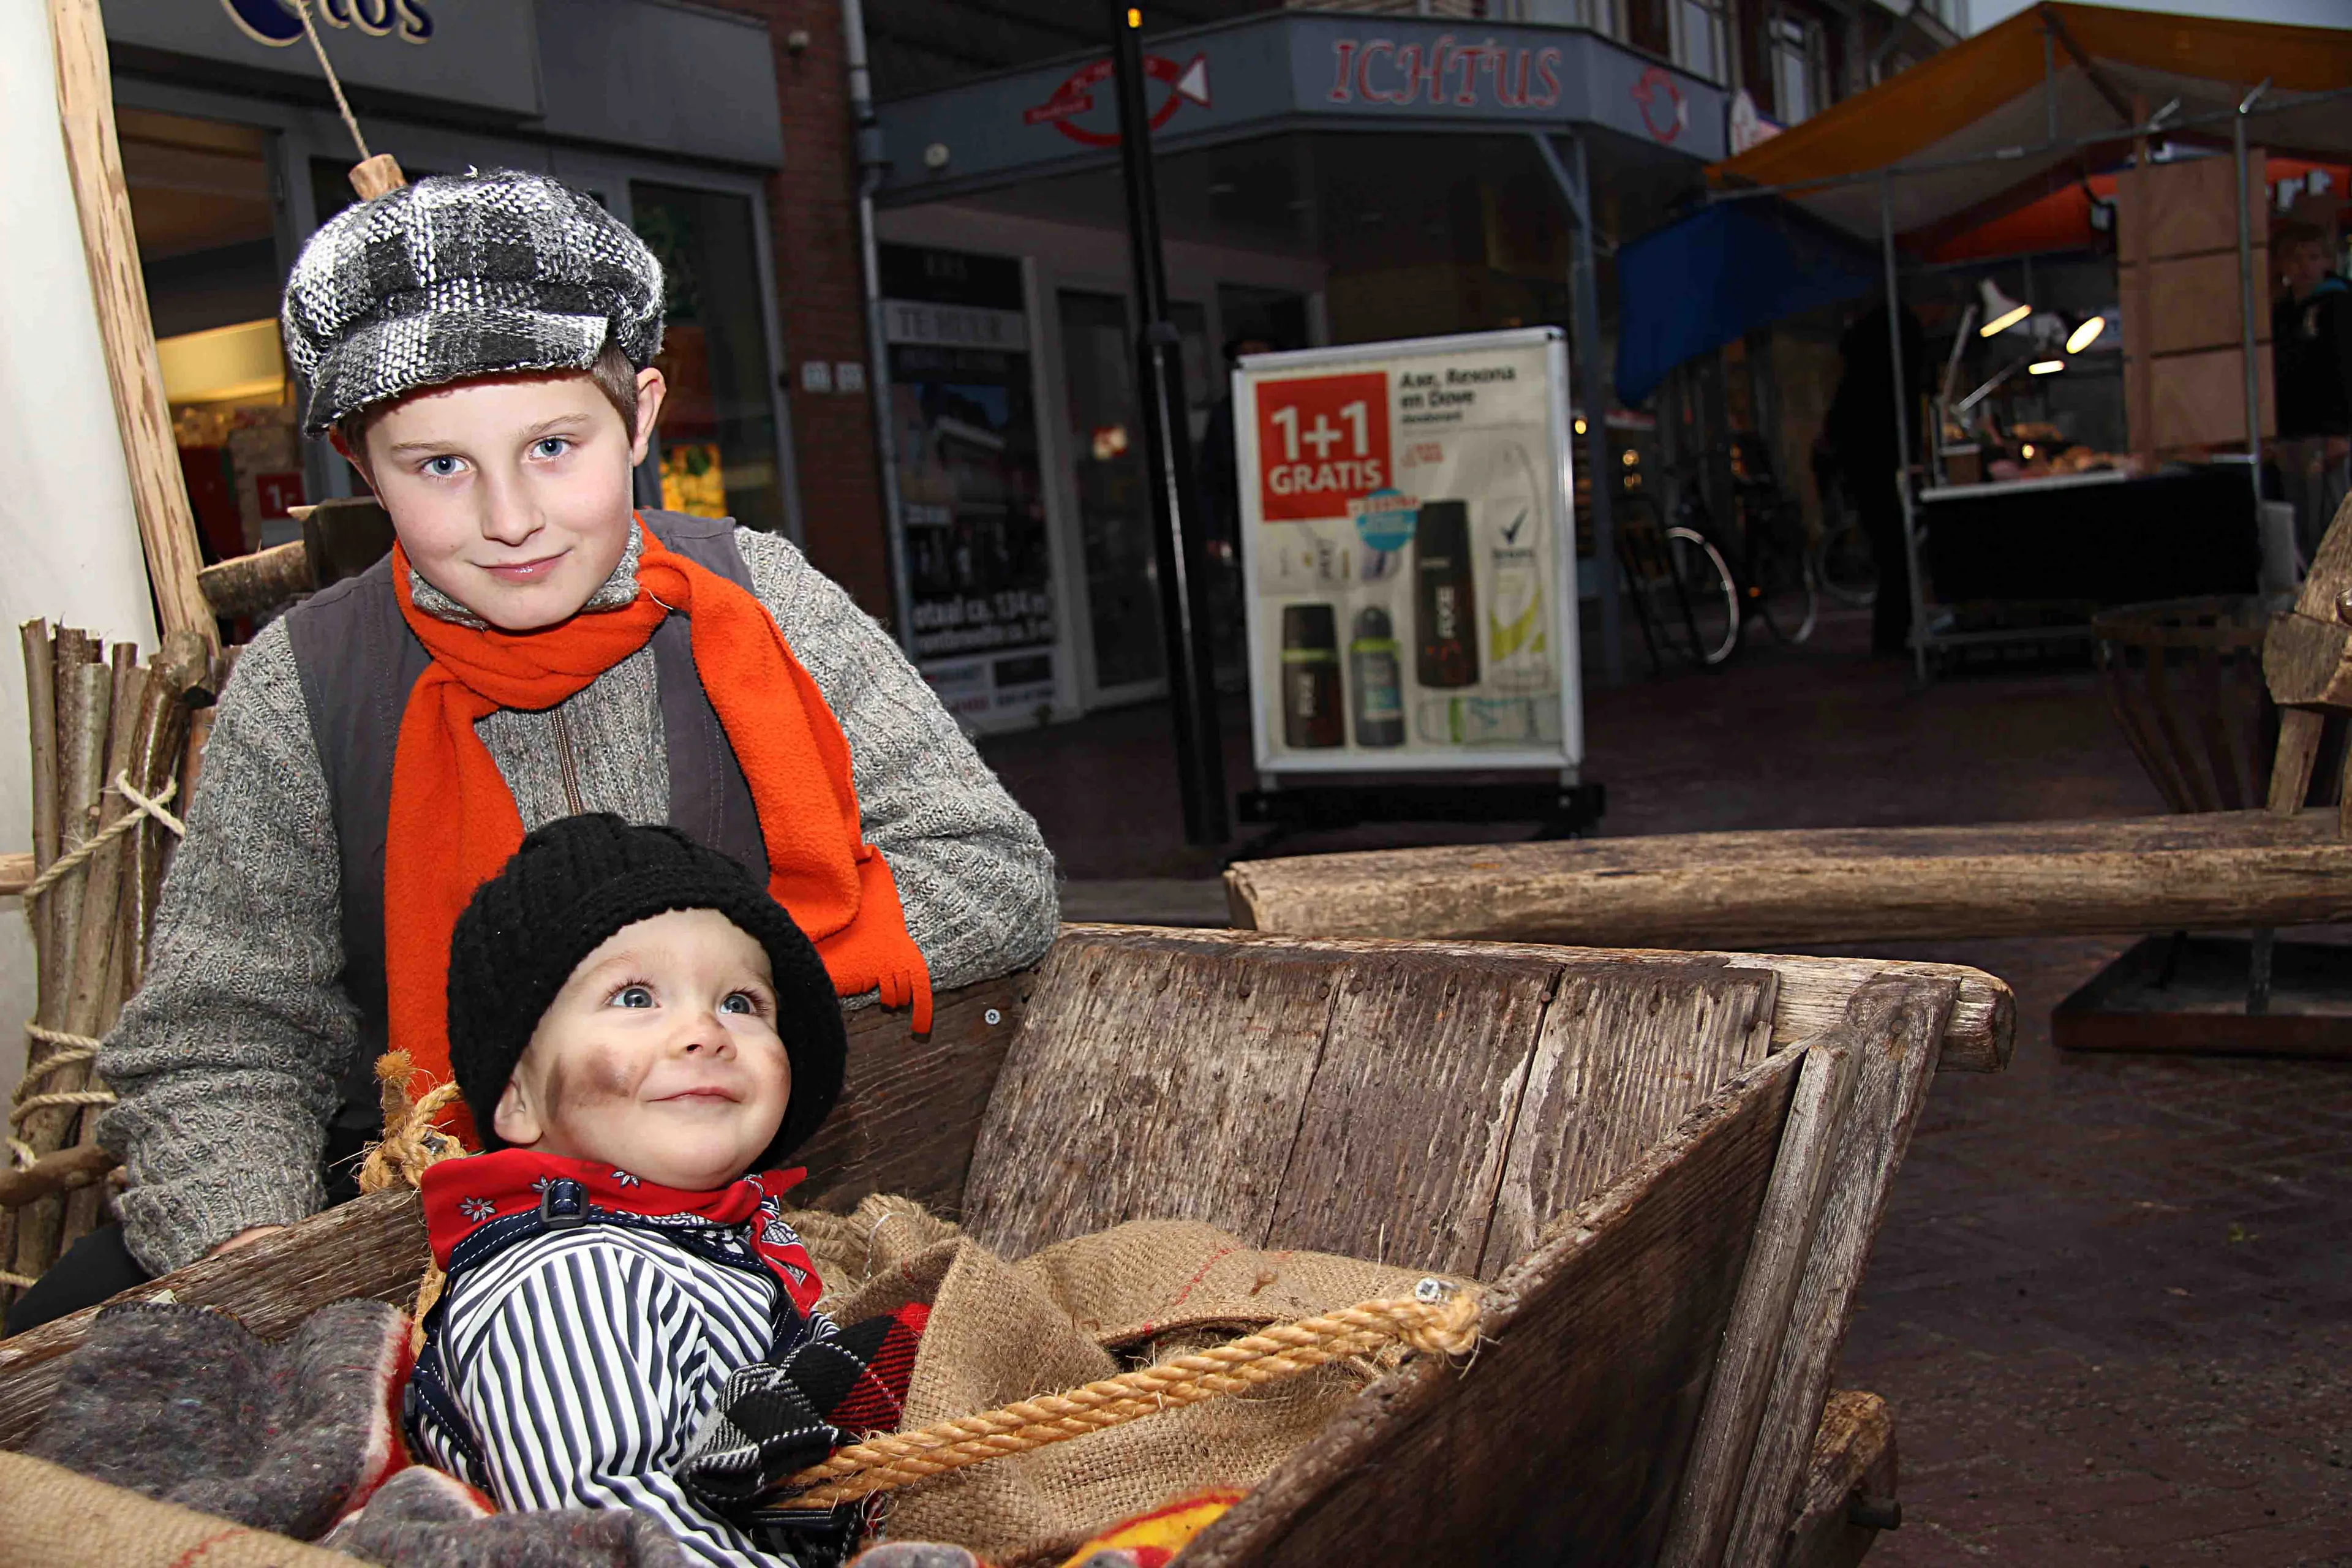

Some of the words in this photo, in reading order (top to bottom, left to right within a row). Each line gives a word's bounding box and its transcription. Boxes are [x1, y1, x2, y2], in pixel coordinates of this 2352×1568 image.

[1327, 33, 1562, 110] ICHTUS
[1446, 366, 1517, 386] Rexona
[1400, 393, 1425, 409] en
[1428, 388, 1476, 409] Dove
[1270, 400, 1370, 462] 1+1
[1268, 458, 1384, 496] GRATIS
